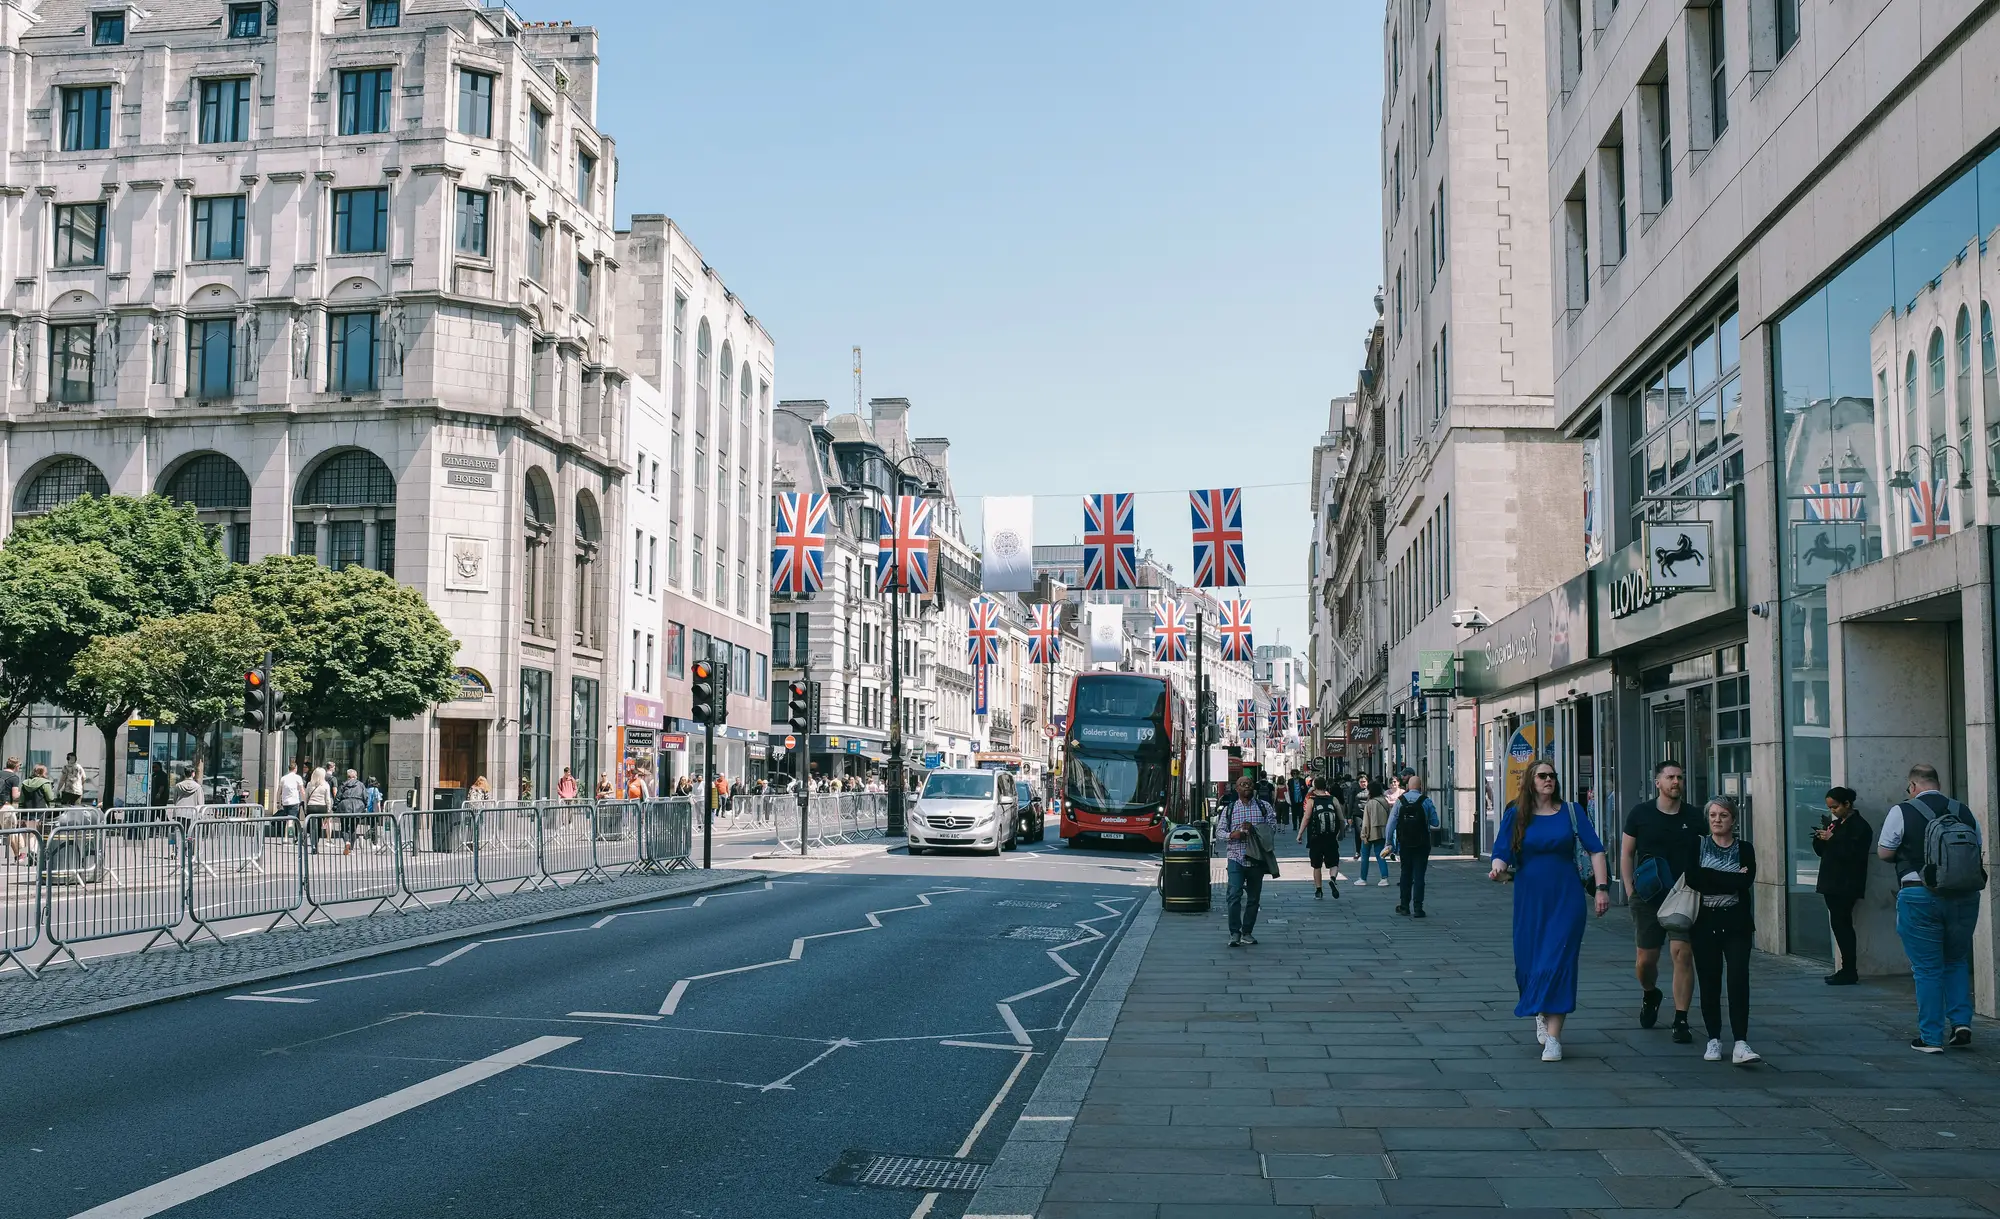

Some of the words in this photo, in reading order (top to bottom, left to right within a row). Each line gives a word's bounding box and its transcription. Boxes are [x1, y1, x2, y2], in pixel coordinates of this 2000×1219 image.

[444, 456, 496, 469] ZIMBABWE
[454, 474, 486, 485] HOUSE
[1485, 634, 1528, 672] Superdrug
[460, 690, 483, 698] STRAND
[1083, 727, 1108, 736] Golders
[1108, 729, 1128, 738] Green
[1137, 727, 1154, 741] 139
[1351, 726, 1373, 734] Pizza
